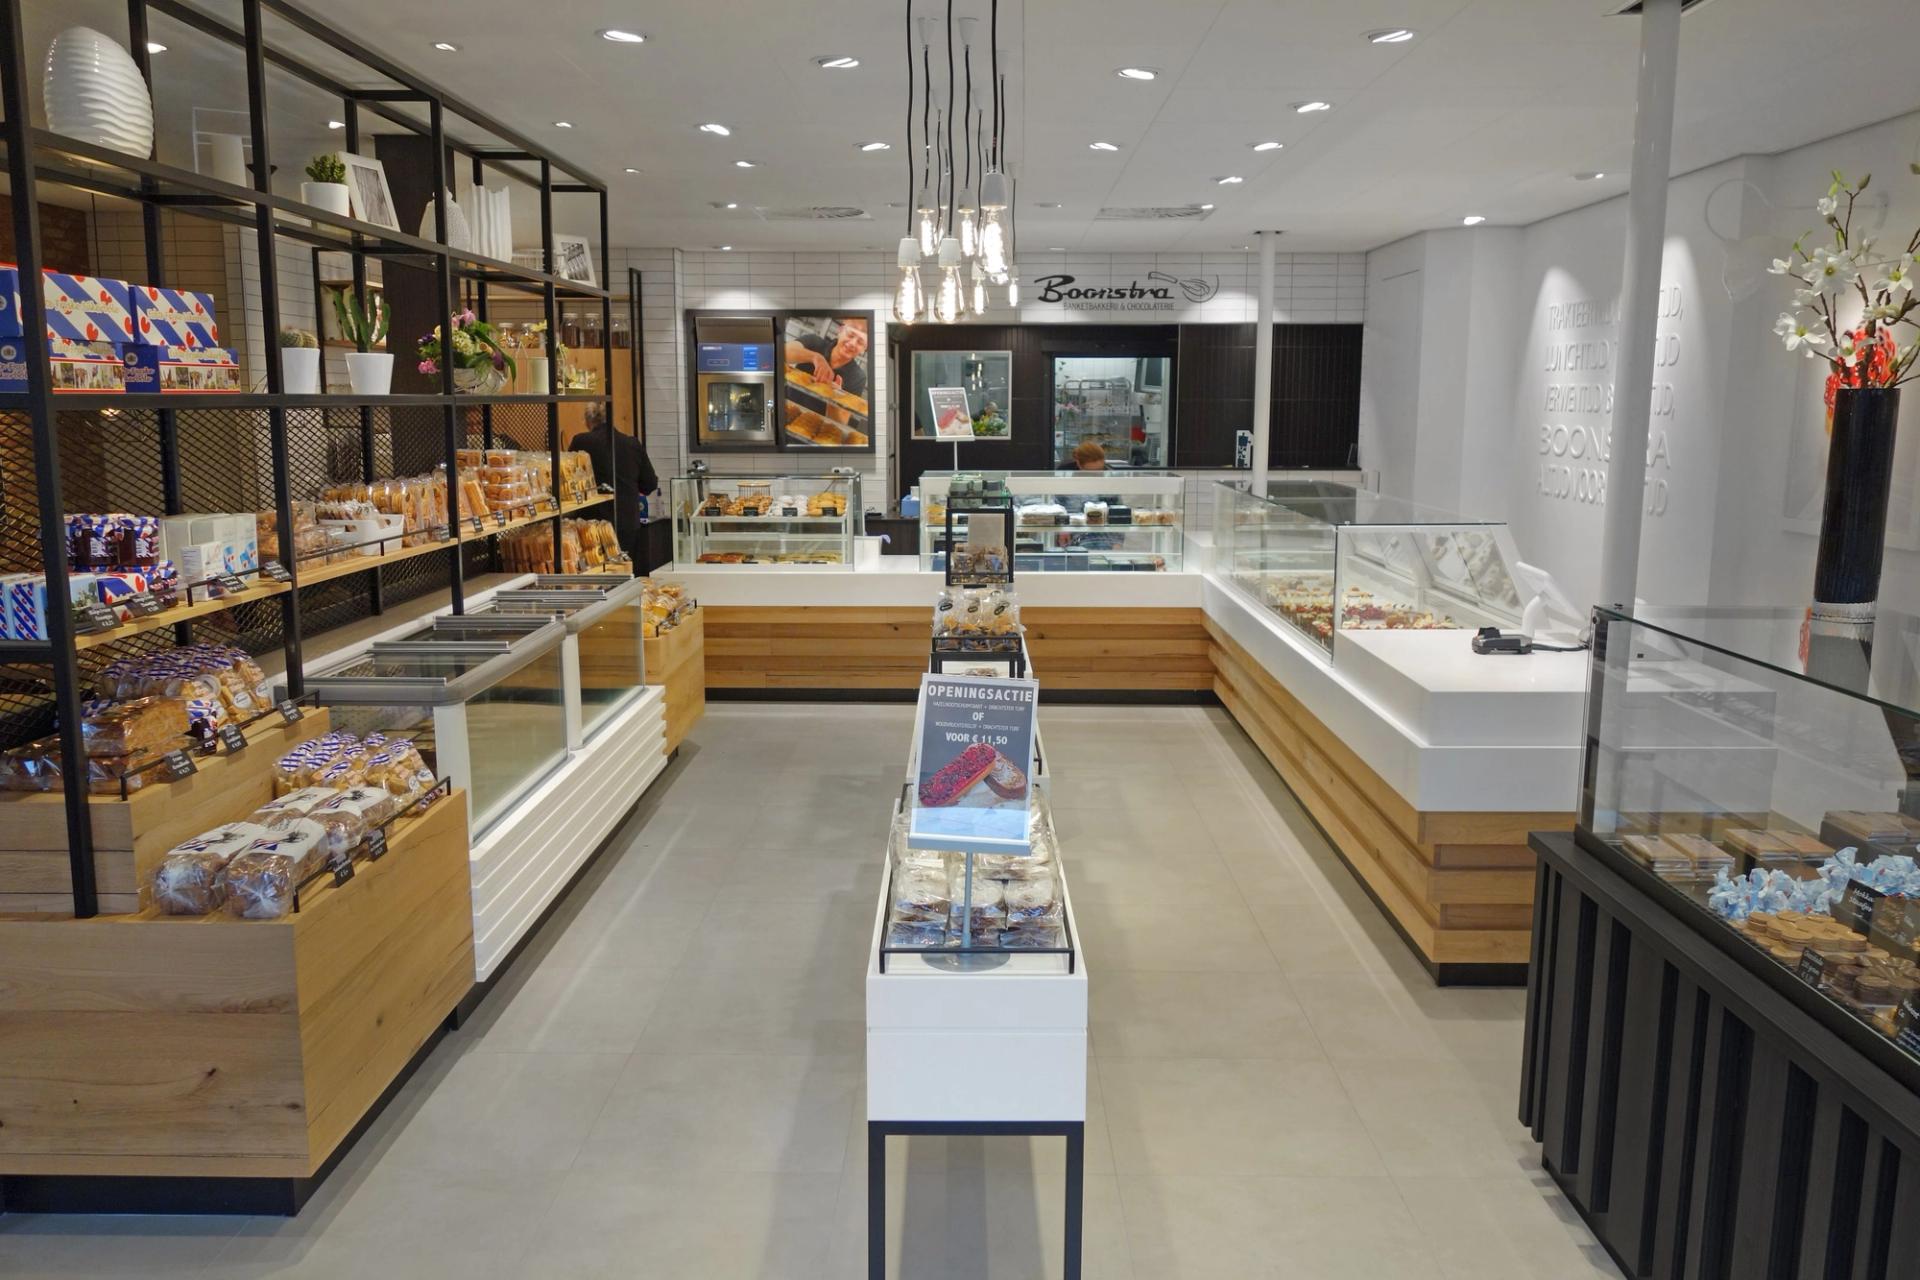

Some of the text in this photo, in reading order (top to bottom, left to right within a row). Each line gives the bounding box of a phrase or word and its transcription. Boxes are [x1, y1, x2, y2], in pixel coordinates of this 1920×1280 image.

[1034, 275, 1174, 302] Boonstra
[1127, 302, 1175, 311] CHOCOLATERIE
[928, 685, 1033, 702] OPENINGSACTIE
[972, 712, 985, 721] OF
[945, 732, 1008, 746] VOOR € 11,50
